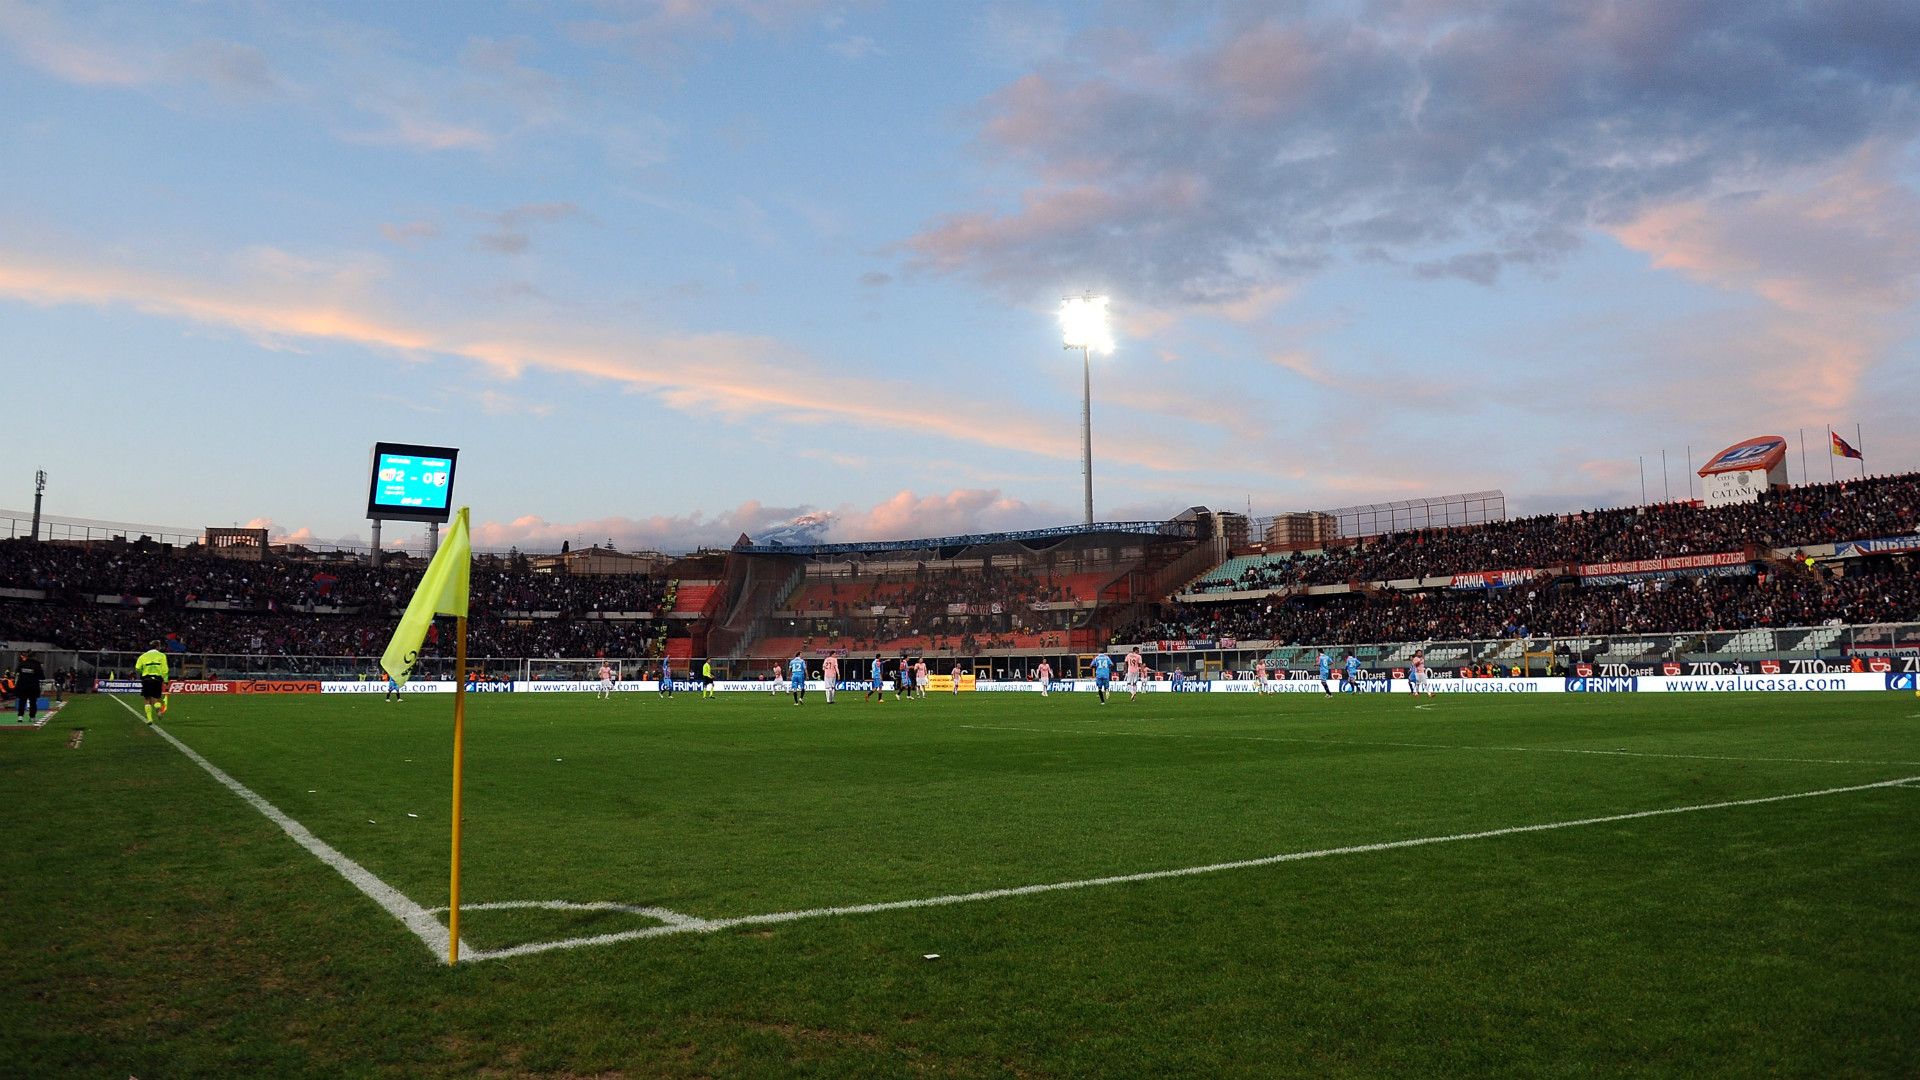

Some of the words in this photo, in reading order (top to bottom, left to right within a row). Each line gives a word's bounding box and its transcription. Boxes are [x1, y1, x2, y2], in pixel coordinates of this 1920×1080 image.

[395, 470, 405, 482] 2
[422, 472, 432, 484] 0
[1711, 486, 1759, 499] CATANIA
[1585, 563, 1611, 576] NOSTRO
[1611, 562, 1638, 573] SANGUE
[1639, 560, 1661, 571] ROSSO
[1666, 557, 1692, 569] NOSTRI
[1693, 555, 1715, 567] CUORI
[1715, 551, 1746, 564] AZZURR
[792, 663, 801, 671] 12
[1097, 661, 1108, 669] 14
[1600, 663, 1628, 677] ZITO
[1689, 662, 1722, 676] ZITO
[1789, 660, 1827, 674] ZITO
[1827, 665, 1851, 673] CAFF
[1236, 671, 1255, 680] ZITO
[1290, 670, 1309, 680] ZITO
[184, 683, 228, 692] COMPUTERS
[254, 683, 318, 692] GIVOVA
[475, 682, 510, 692] FRIMM
[672, 681, 704, 691] FRIMM
[846, 681, 873, 691] FRIMM
[1052, 682, 1074, 691] FRIMM
[1182, 681, 1209, 692] FRIMM
[1586, 677, 1632, 691] FRIMM
[1665, 676, 1846, 691] www.valucasa.com
